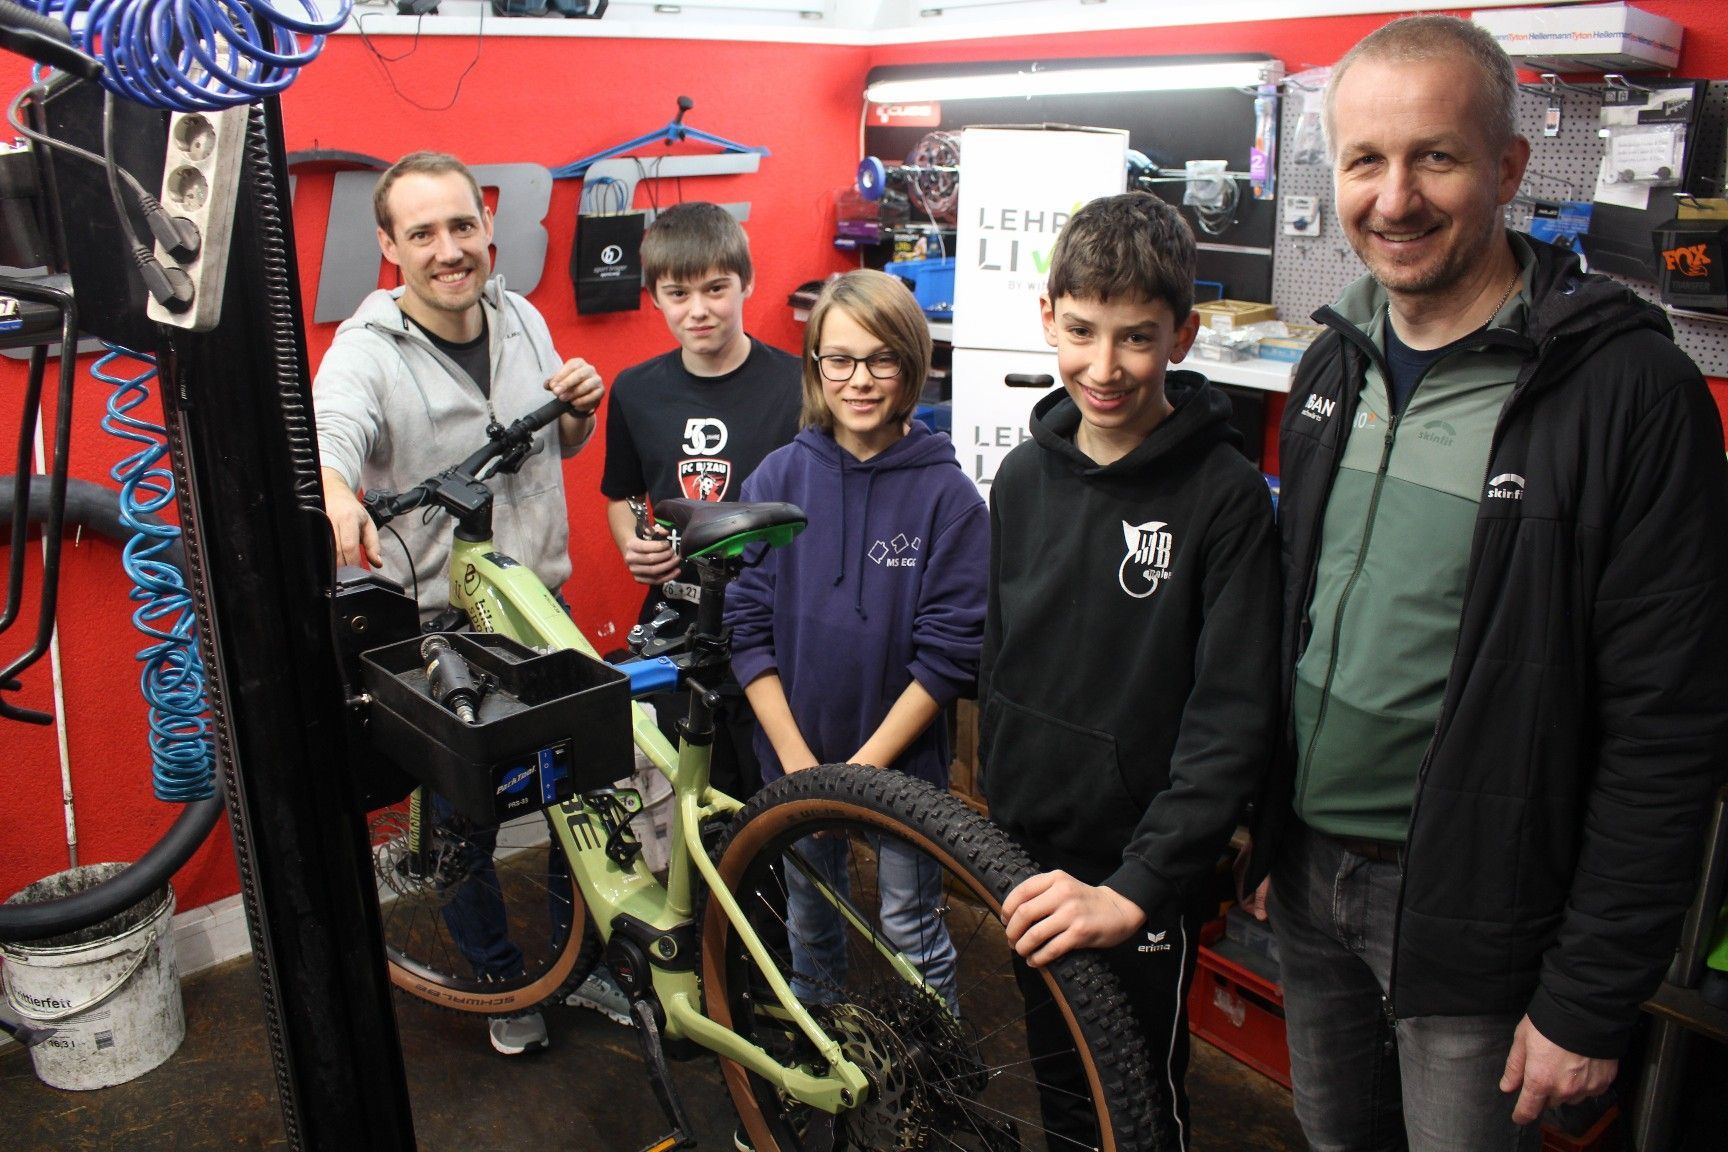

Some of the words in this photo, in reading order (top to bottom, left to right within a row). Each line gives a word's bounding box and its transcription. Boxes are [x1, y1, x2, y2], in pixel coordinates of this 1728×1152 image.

[1529, 32, 1592, 41] HellermannTyton
[1662, 244, 1712, 272] FOX
[682, 417, 728, 456] 50
[1417, 431, 1455, 447] skinfit
[682, 463, 694, 474] FC
[695, 461, 727, 474] BIZAU
[886, 558, 900, 567] MS
[496, 764, 537, 796] ParkTool
[1137, 943, 1172, 953] erima
[415, 983, 516, 1006] SCHWALBE
